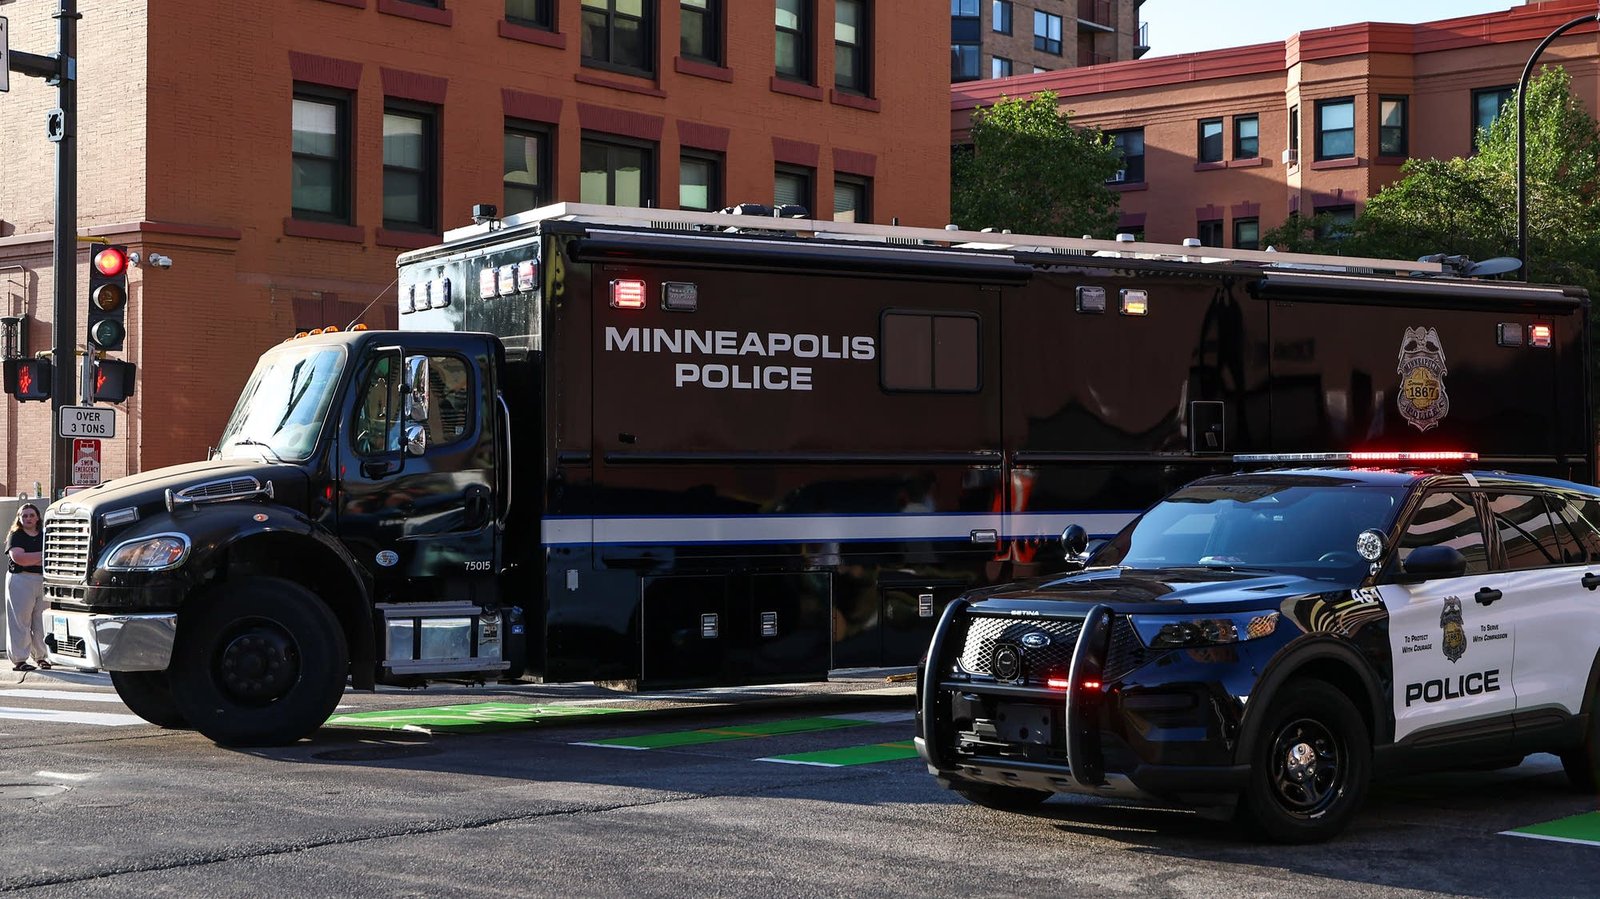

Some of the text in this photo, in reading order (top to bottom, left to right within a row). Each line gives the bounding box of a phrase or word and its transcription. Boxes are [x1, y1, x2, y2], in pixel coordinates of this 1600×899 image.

[605, 326, 875, 360] MINNEAPOLIS
[675, 363, 813, 390] POLICE
[1409, 387, 1436, 398] 1867
[76, 411, 100, 421] OVER
[71, 423, 105, 433] 3 TONS
[464, 561, 490, 571] 75015
[1406, 669, 1501, 707] POLICE
